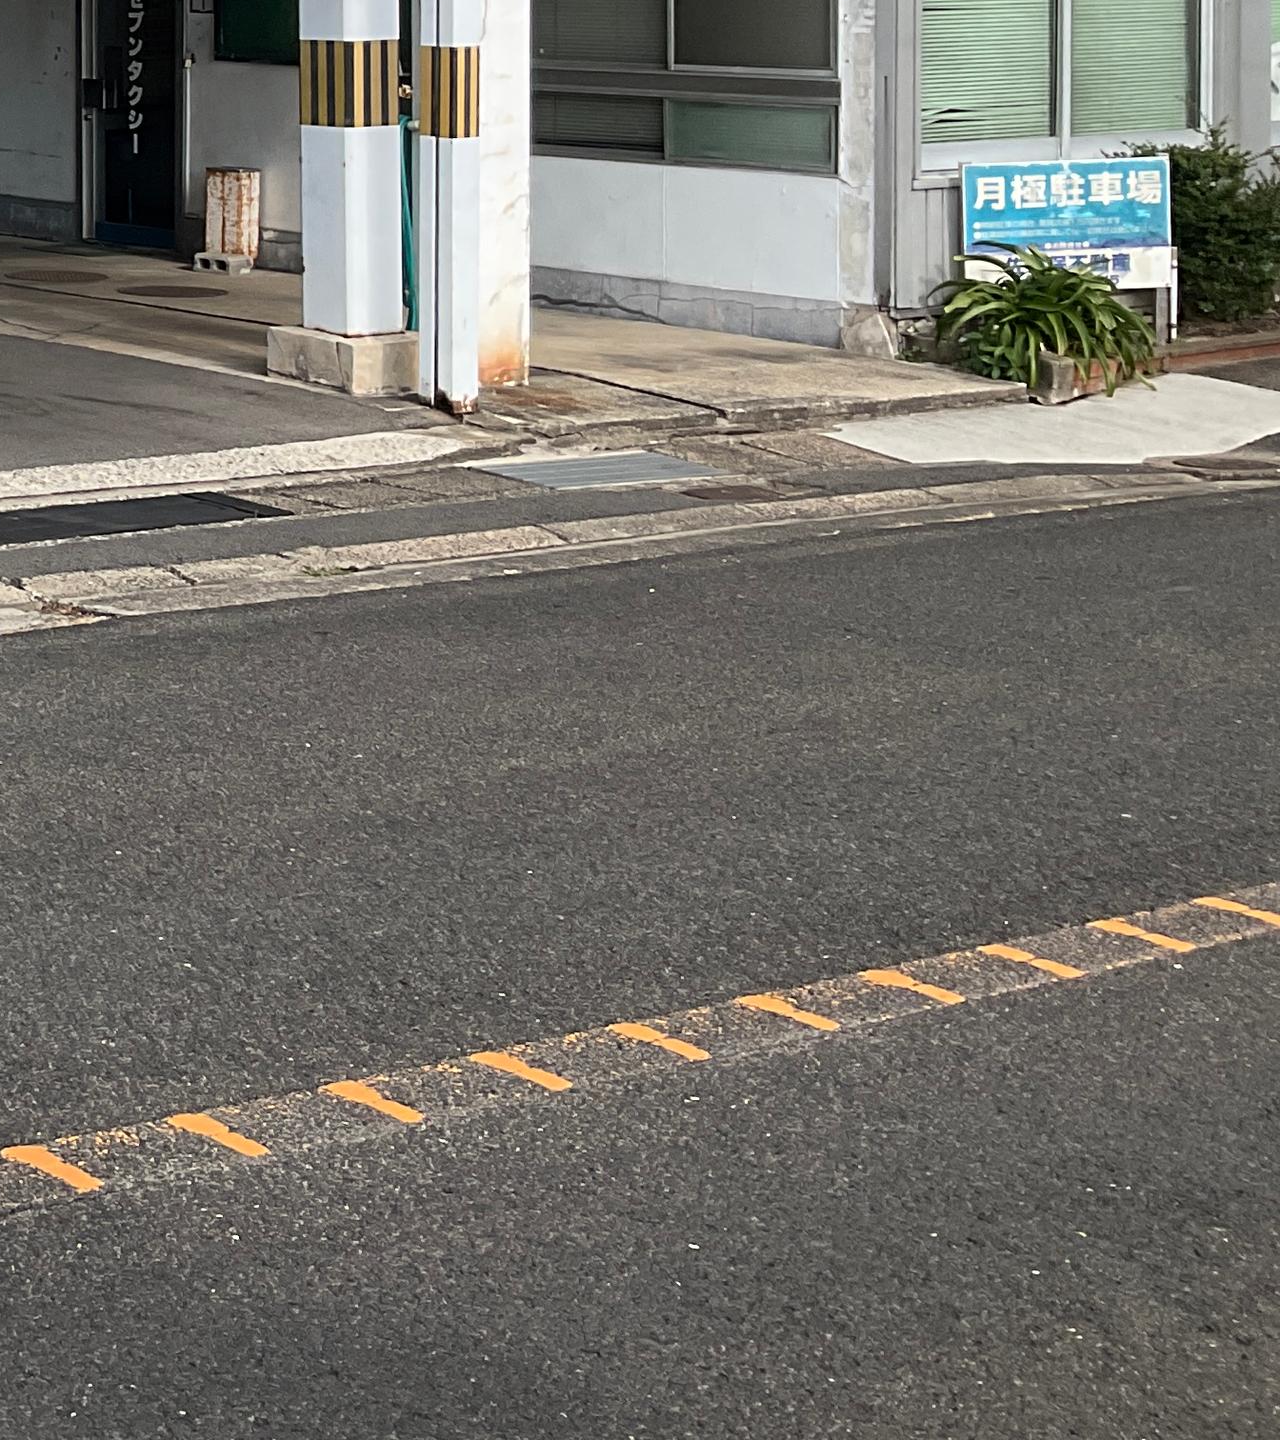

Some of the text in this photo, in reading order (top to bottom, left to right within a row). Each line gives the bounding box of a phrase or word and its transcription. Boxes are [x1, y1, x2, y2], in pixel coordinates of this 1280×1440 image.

[973, 169, 1162, 211] 月極駐車場
